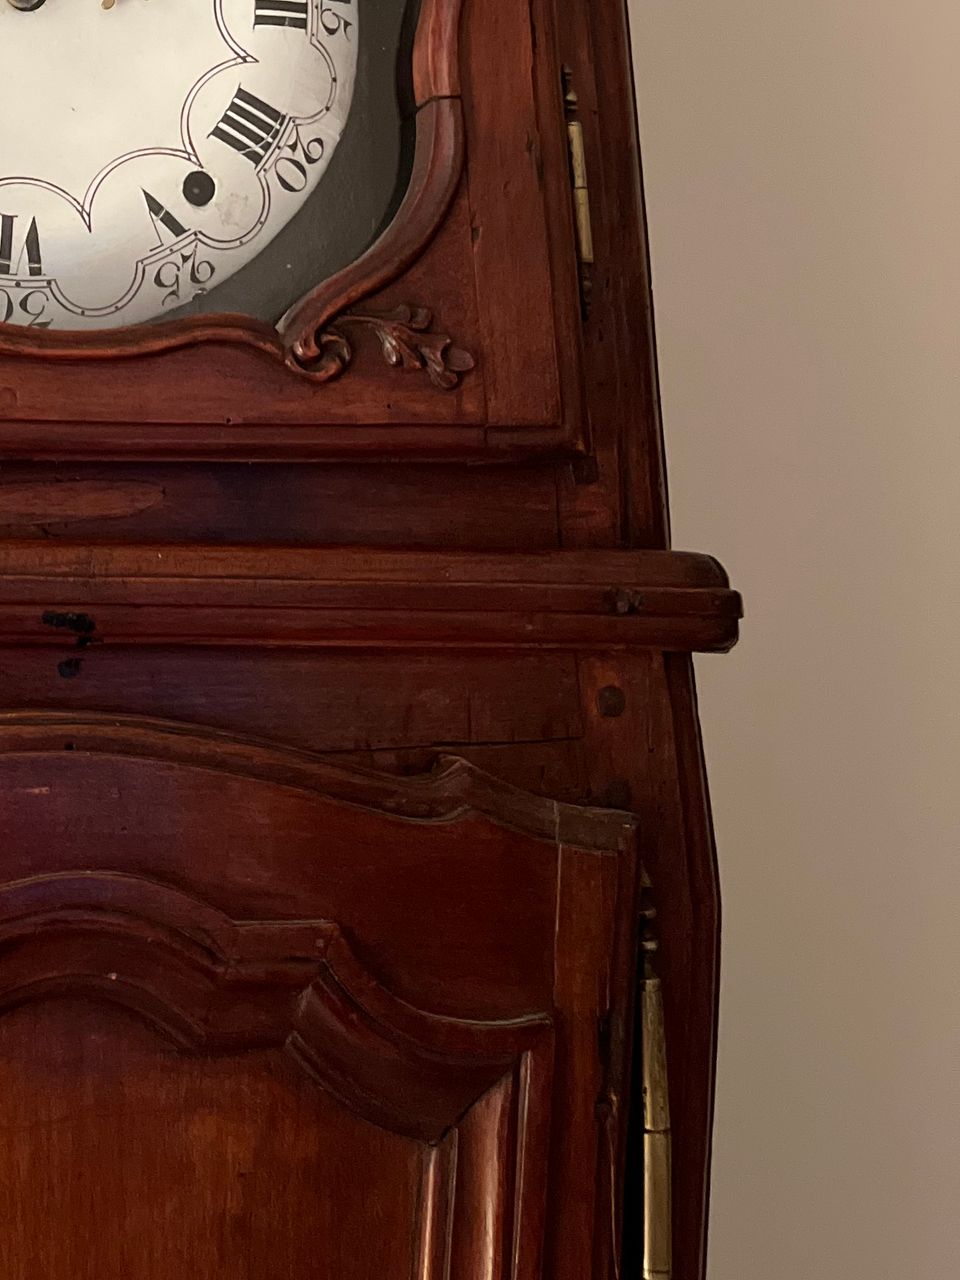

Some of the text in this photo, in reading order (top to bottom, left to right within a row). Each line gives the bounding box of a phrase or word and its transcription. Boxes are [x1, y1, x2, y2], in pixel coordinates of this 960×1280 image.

[207, 83, 290, 173] IIII
[274, 125, 324, 193] 20
[141, 186, 191, 252] V
[154, 242, 216, 306] 25
